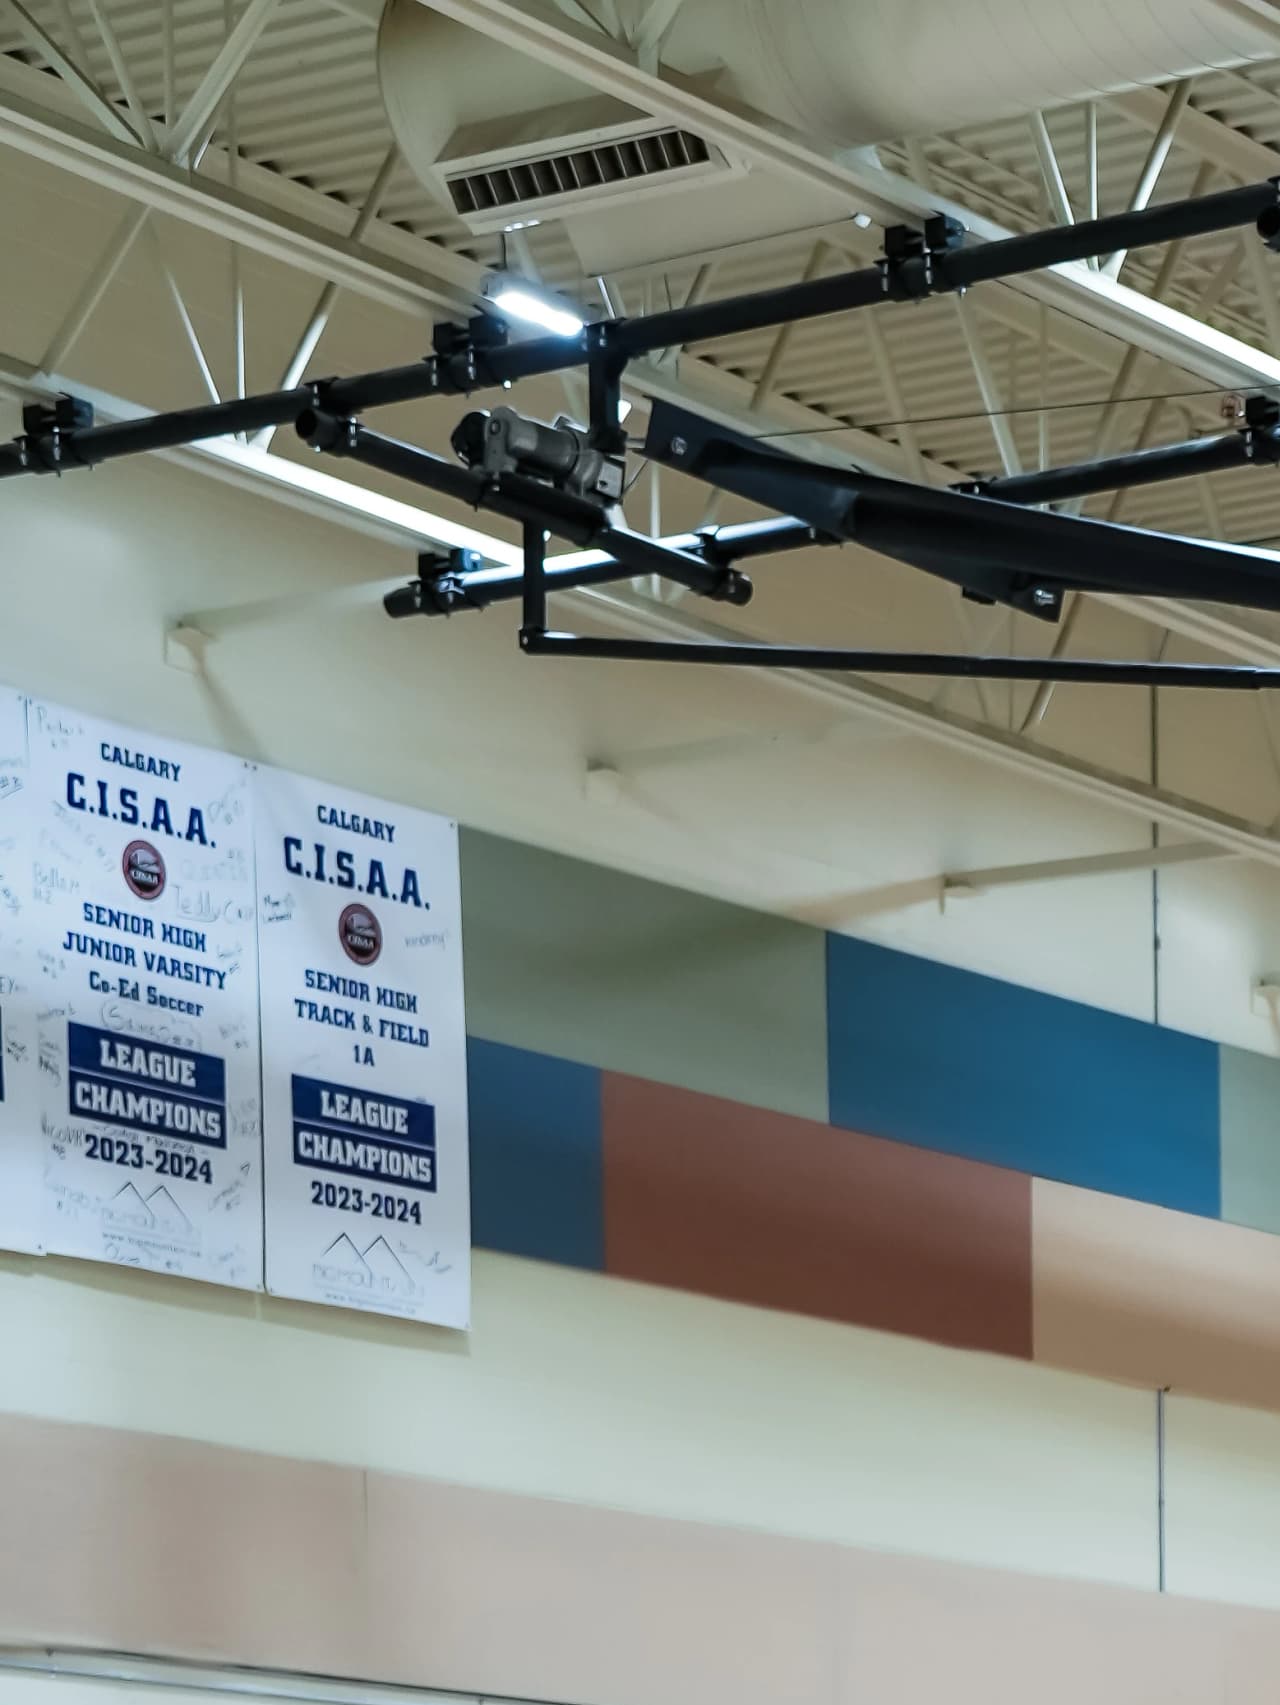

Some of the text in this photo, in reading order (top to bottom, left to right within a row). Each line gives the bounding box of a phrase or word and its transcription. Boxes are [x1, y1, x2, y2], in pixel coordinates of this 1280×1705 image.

[101, 743, 181, 782] CALGARY
[66, 772, 218, 849] C.I.S.A.A.
[317, 804, 396, 843] CALGARY
[284, 836, 431, 911] C.I.S.A.A.
[83, 902, 207, 952] SENIOR HIGH
[63, 931, 227, 989] JUNIOR VARSITY
[89, 971, 204, 1017] Co-Ed Soccer
[305, 969, 418, 1014] SENIOR HIGH
[294, 998, 429, 1048] TRACK & FIELD
[100, 1039, 196, 1088] LEAGUE
[353, 1045, 375, 1067] 1A
[75, 1080, 221, 1139] CHAMPIONS
[320, 1090, 408, 1134] LEAGUE
[85, 1134, 213, 1185] 2023-2024
[298, 1131, 432, 1183] CHAMPIONS
[311, 1181, 422, 1226] 2023-2024
